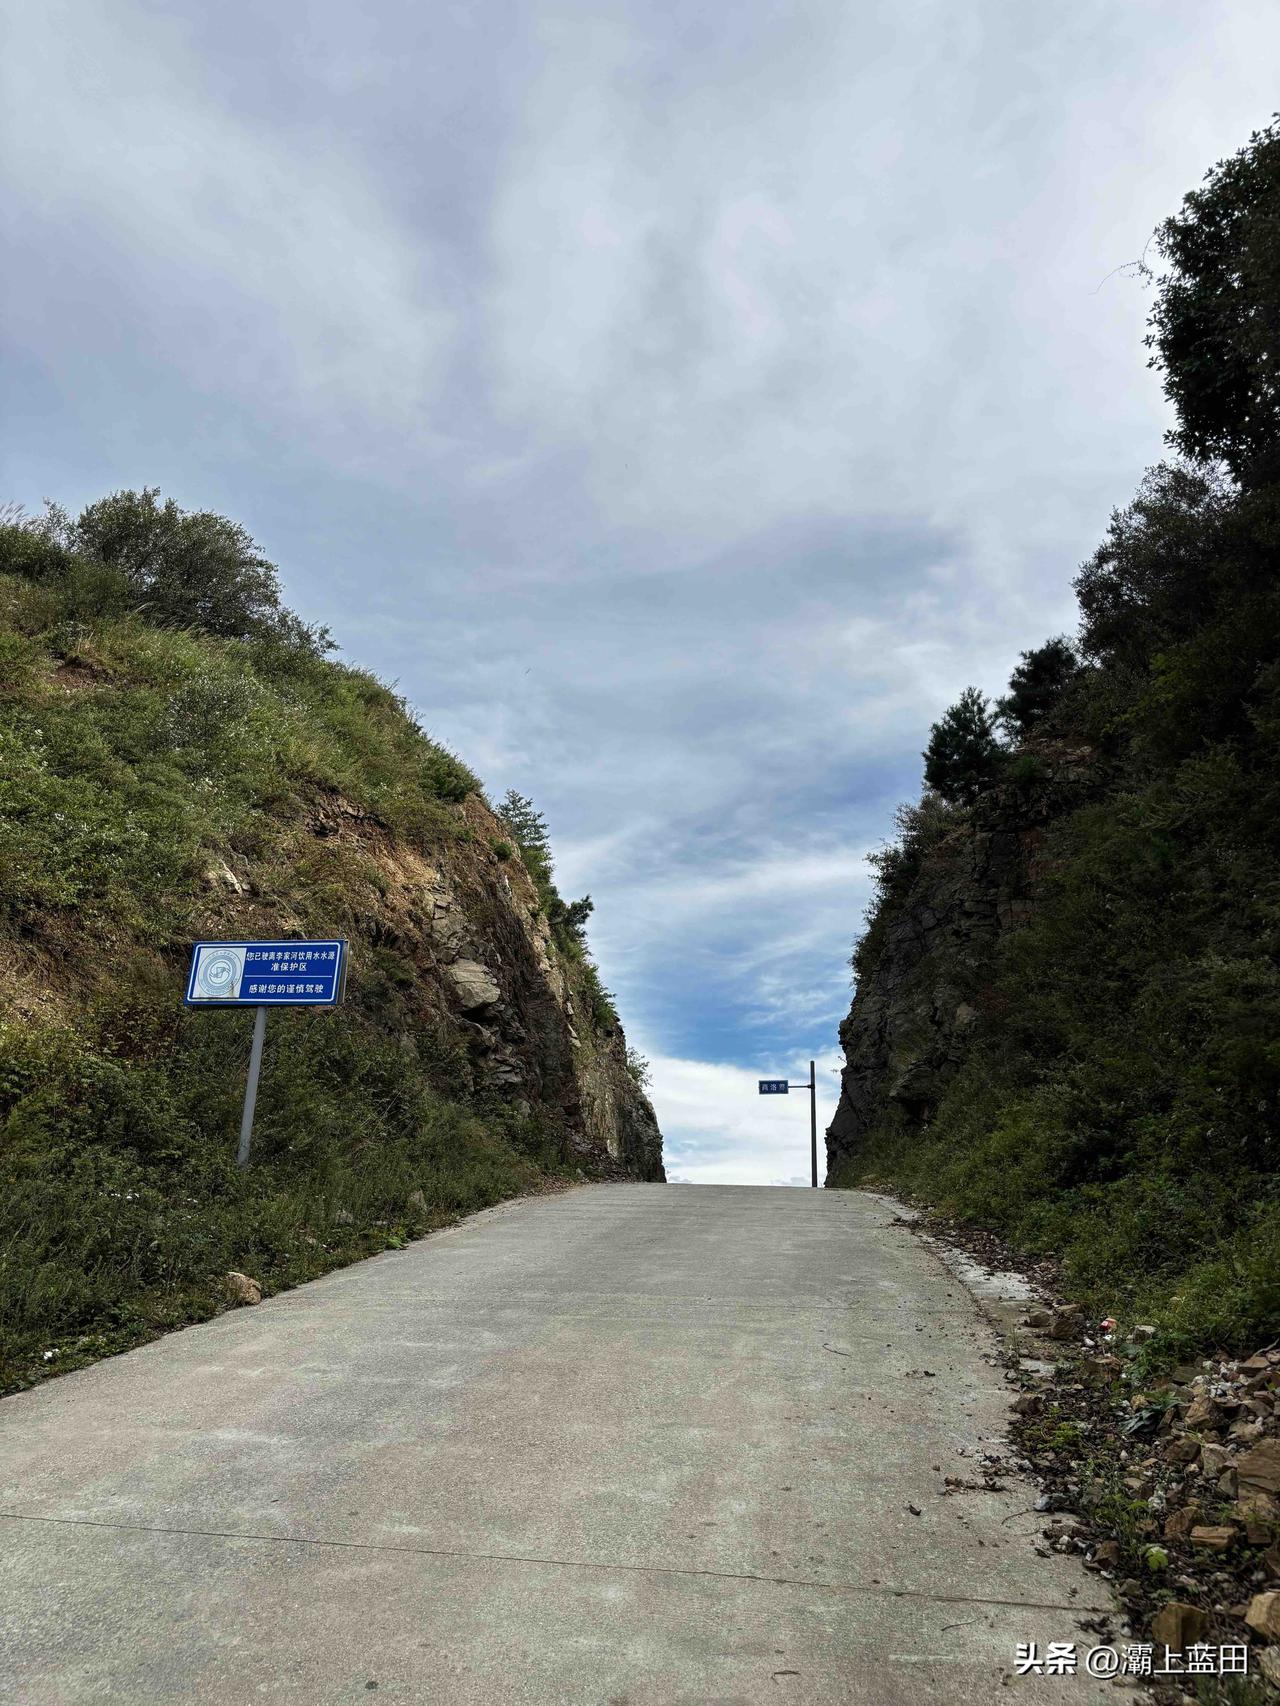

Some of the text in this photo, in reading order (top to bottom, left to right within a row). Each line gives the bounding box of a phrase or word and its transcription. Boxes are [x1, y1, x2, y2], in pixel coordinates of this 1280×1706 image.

[271, 962, 308, 972] 准保护区
[249, 984, 324, 994] 感谢您的谨慎驾驶
